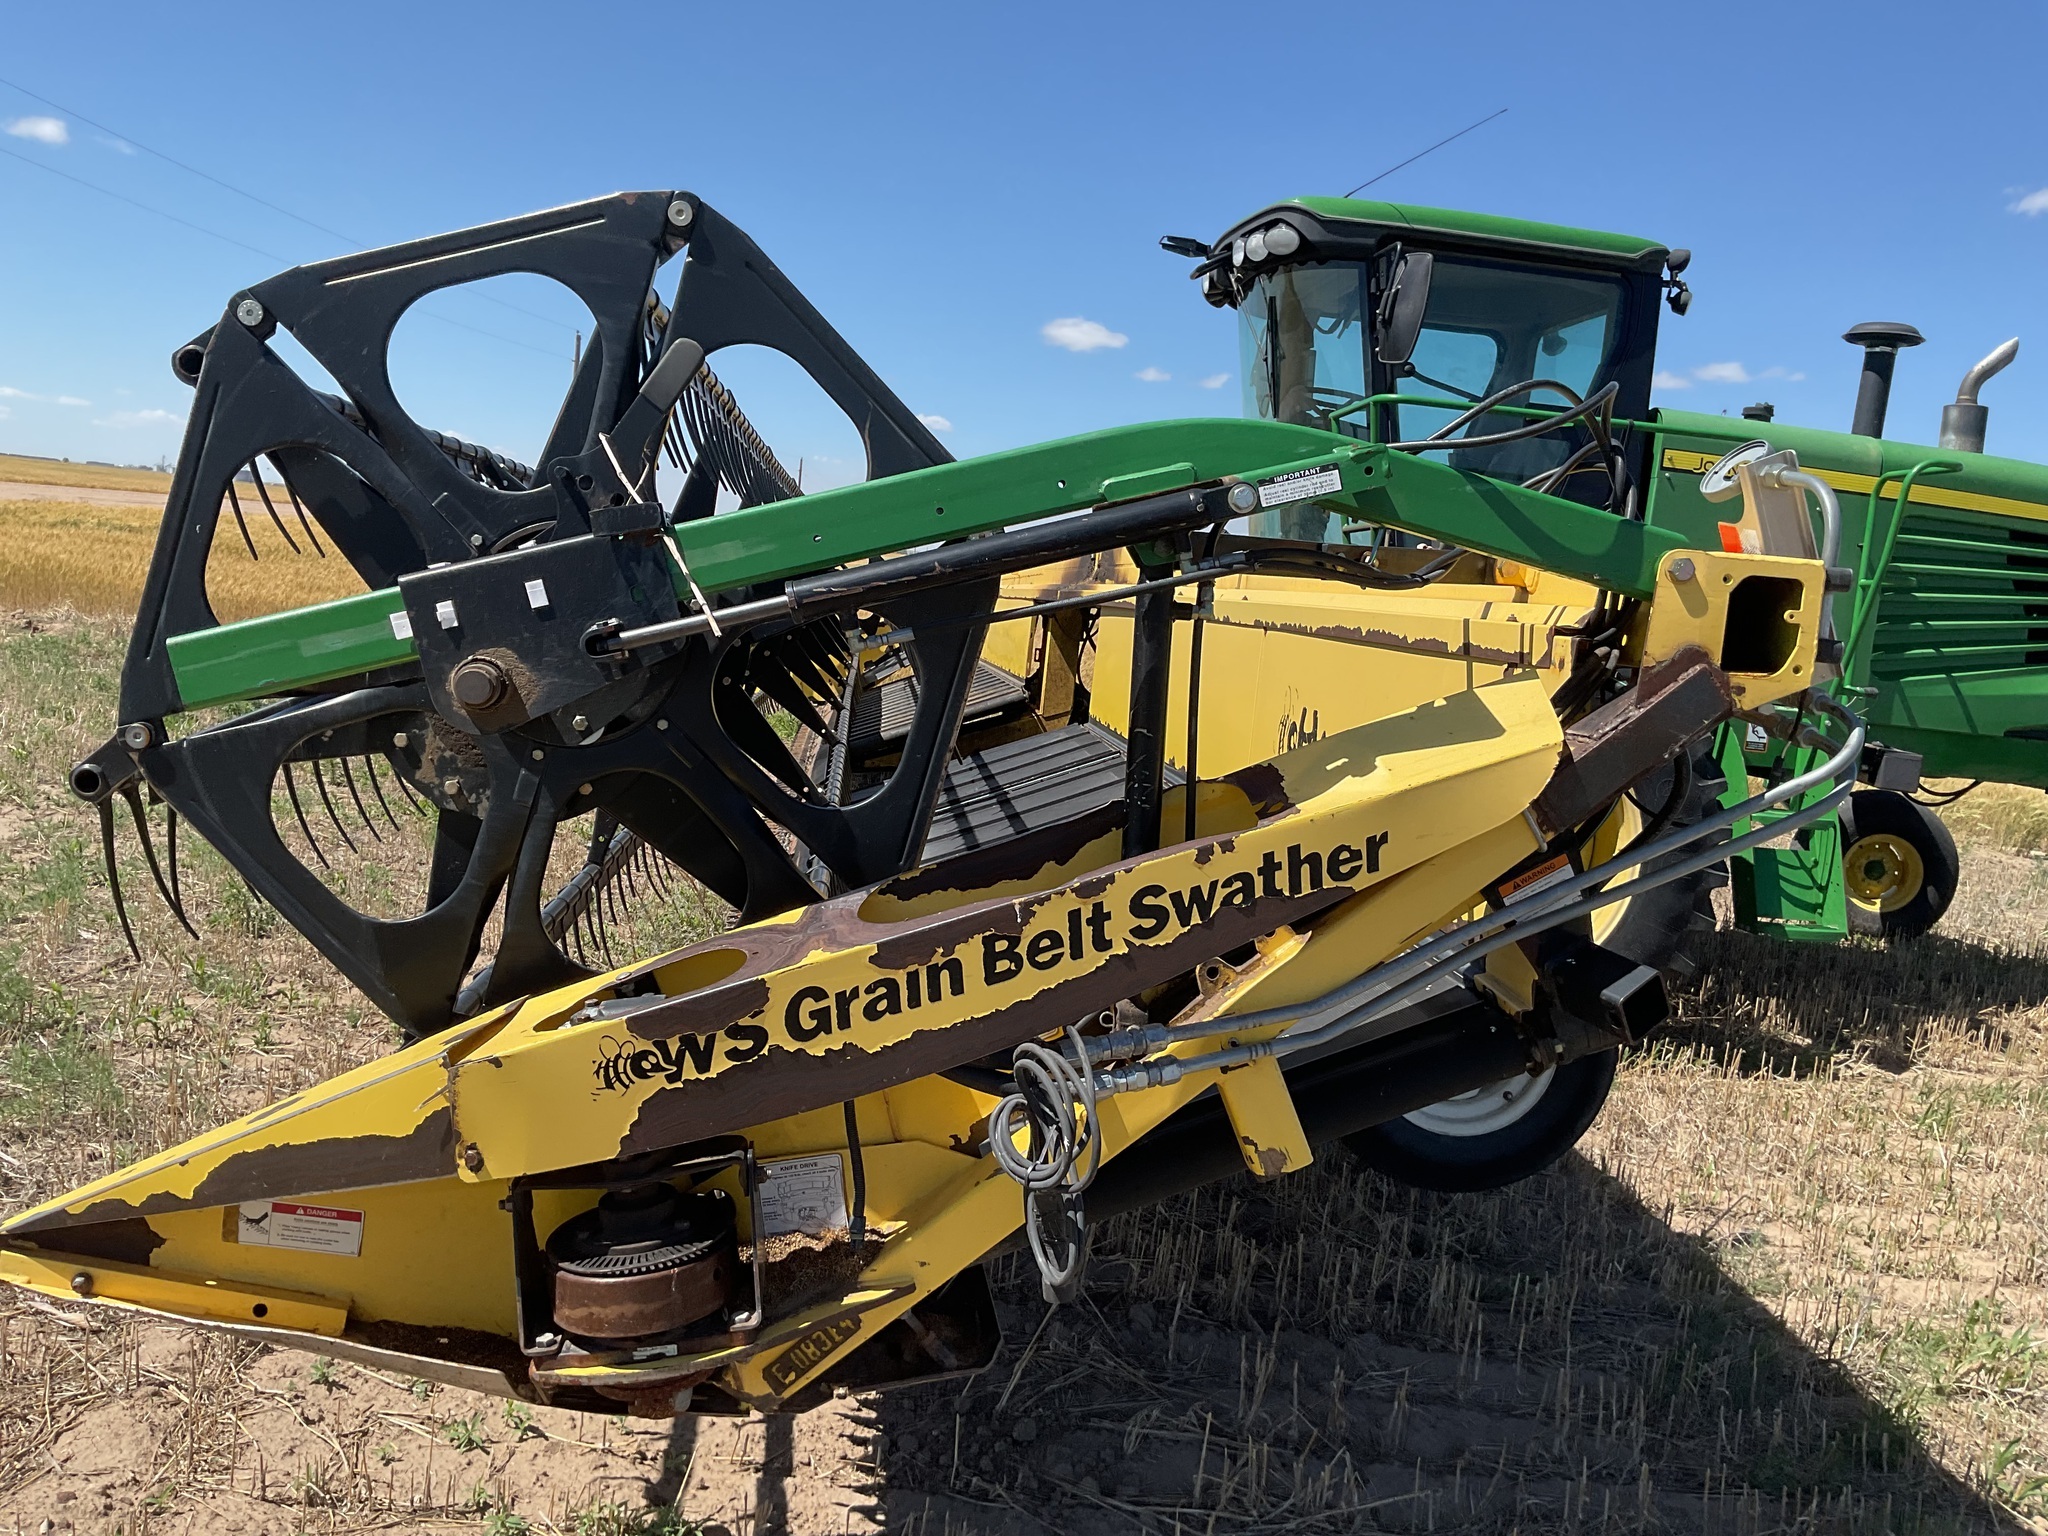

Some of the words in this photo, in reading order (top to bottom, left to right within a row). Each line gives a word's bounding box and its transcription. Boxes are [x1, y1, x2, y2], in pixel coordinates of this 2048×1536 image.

[1274, 467, 1321, 482] IMPORTANT
[1520, 862, 1556, 884] WARNING
[784, 953, 965, 1042] Grain
[982, 900, 1113, 987] Belt
[1128, 830, 1389, 940] Swather
[306, 1208, 337, 1217] DANGER
